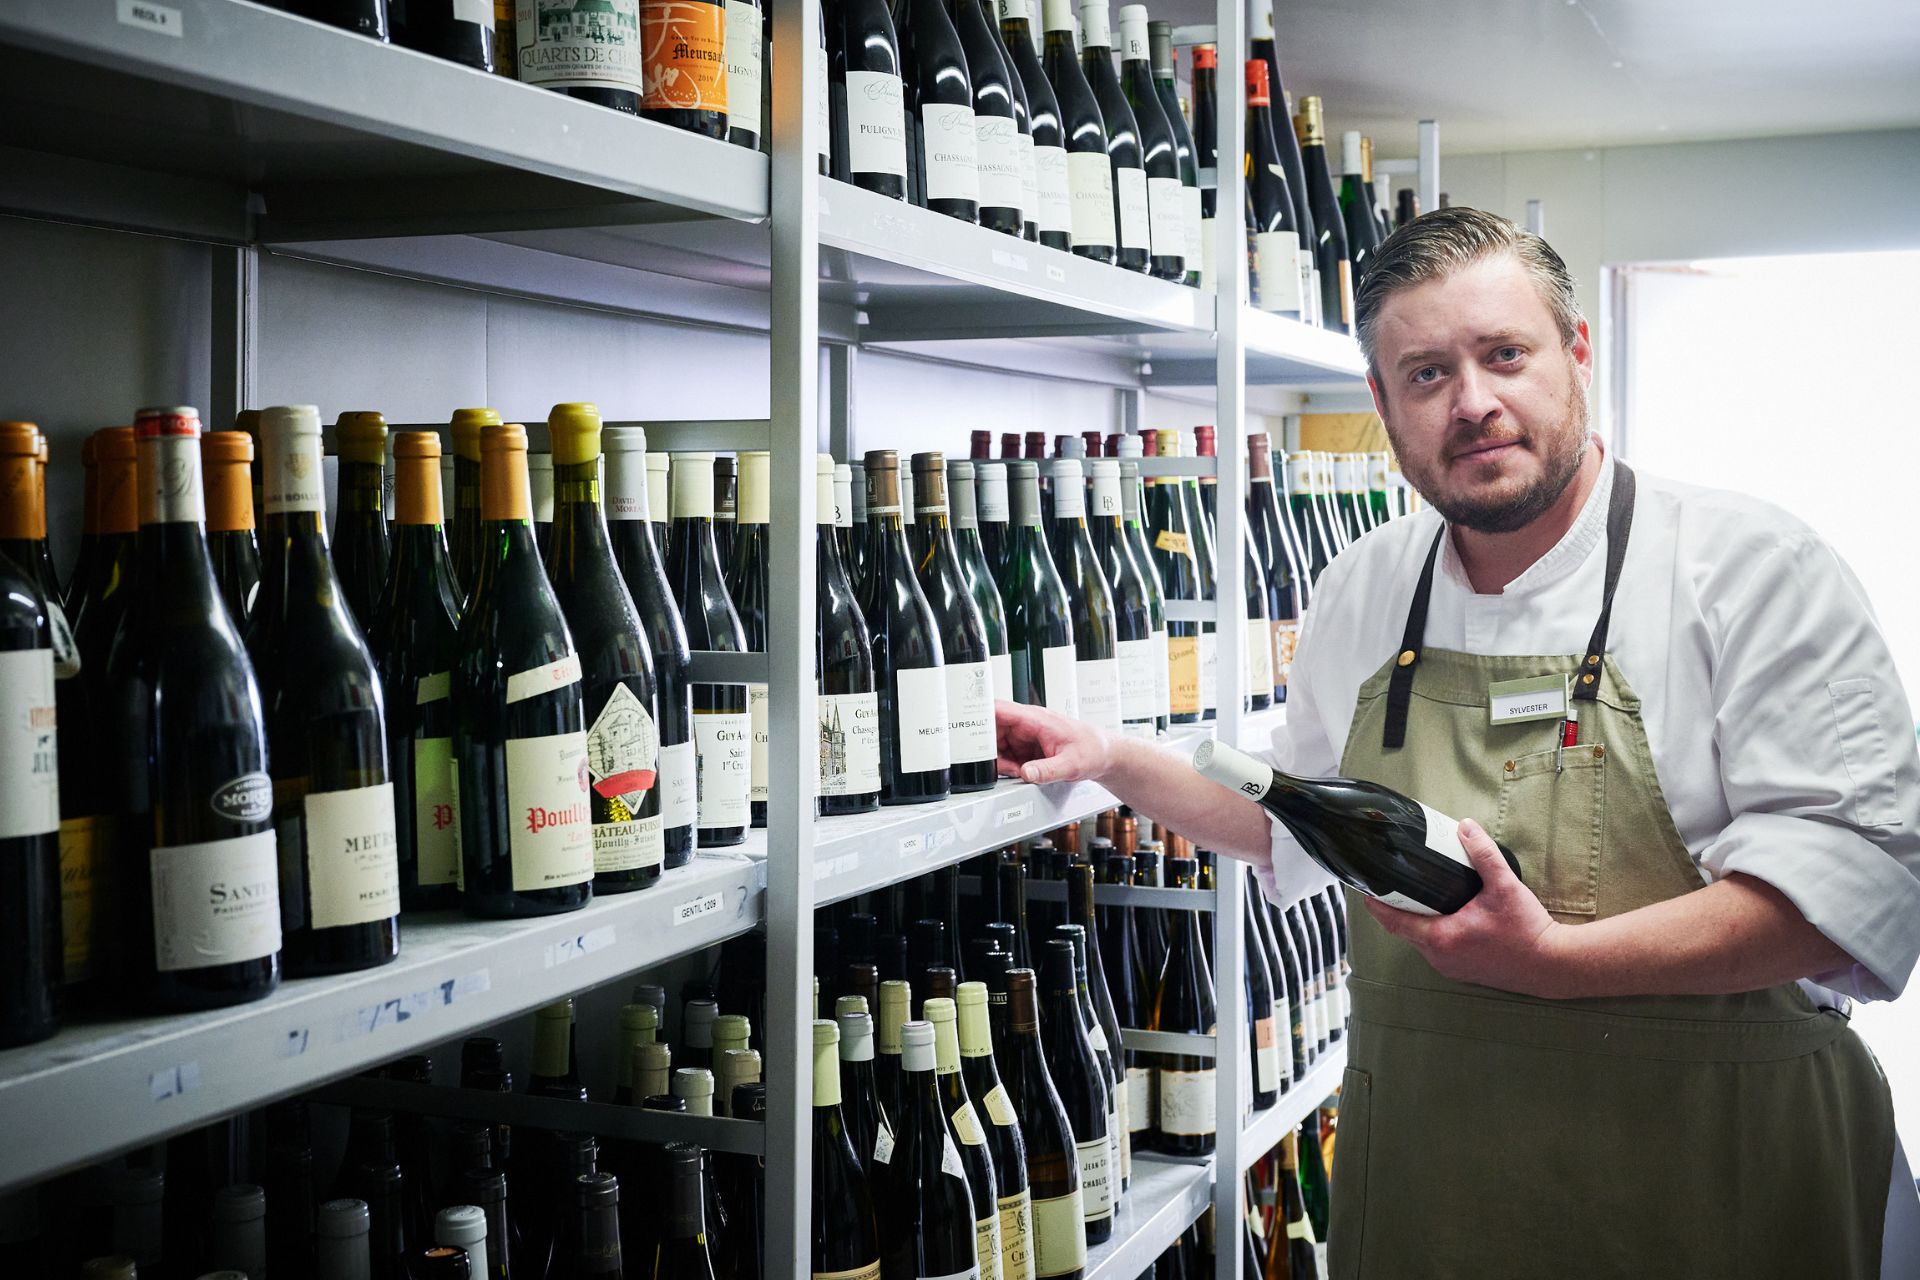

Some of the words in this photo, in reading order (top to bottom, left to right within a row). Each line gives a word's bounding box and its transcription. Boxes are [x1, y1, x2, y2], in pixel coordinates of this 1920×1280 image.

[521, 46, 581, 68] QUARTS
[583, 46, 605, 62] DE
[1509, 703, 1548, 716] SYLVESTER
[716, 730, 736, 742] GUY
[755, 731, 768, 744] CH
[432, 803, 453, 831] P
[681, 903, 702, 918] GENTIL
[704, 898, 717, 911] 1209
[1083, 1162, 1099, 1172] JEAN
